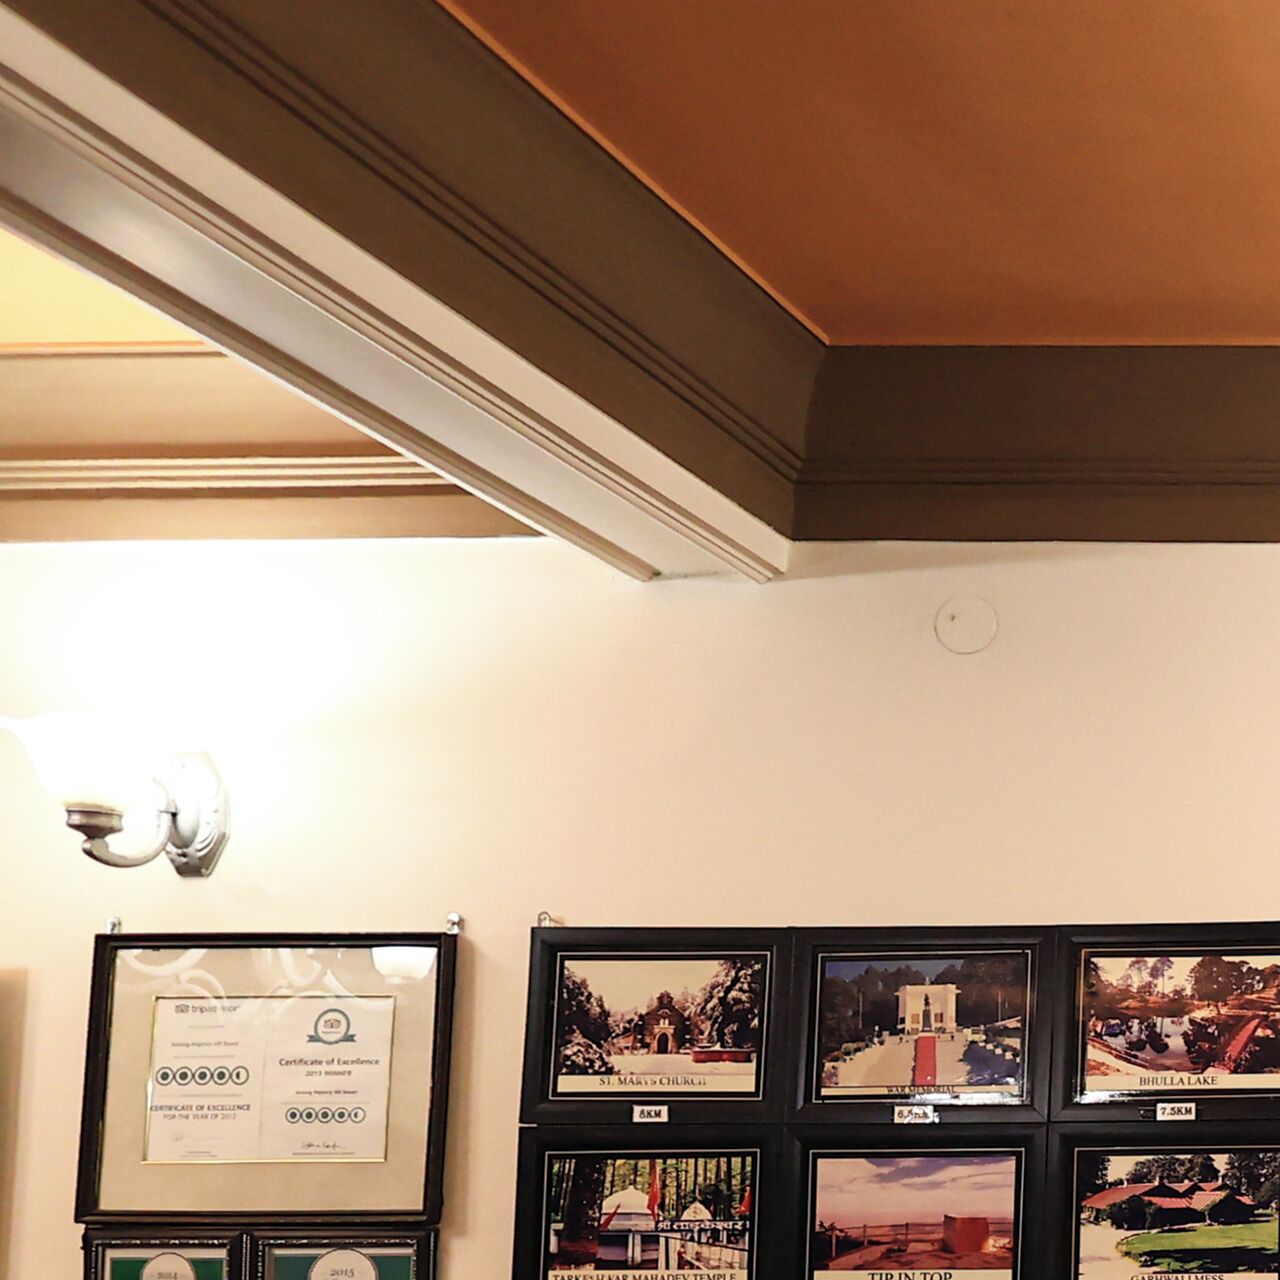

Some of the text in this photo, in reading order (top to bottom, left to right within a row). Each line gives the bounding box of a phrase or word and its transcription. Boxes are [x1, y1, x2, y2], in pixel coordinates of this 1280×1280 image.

[279, 1058, 324, 1066] Certificate
[325, 1058, 335, 1066] of
[659, 1076, 707, 1085] CHURCH
[1139, 1076, 1218, 1086] BHULLA LAKE
[1160, 1106, 1193, 1116] 7.5KM
[330, 1269, 355, 1278] 2015
